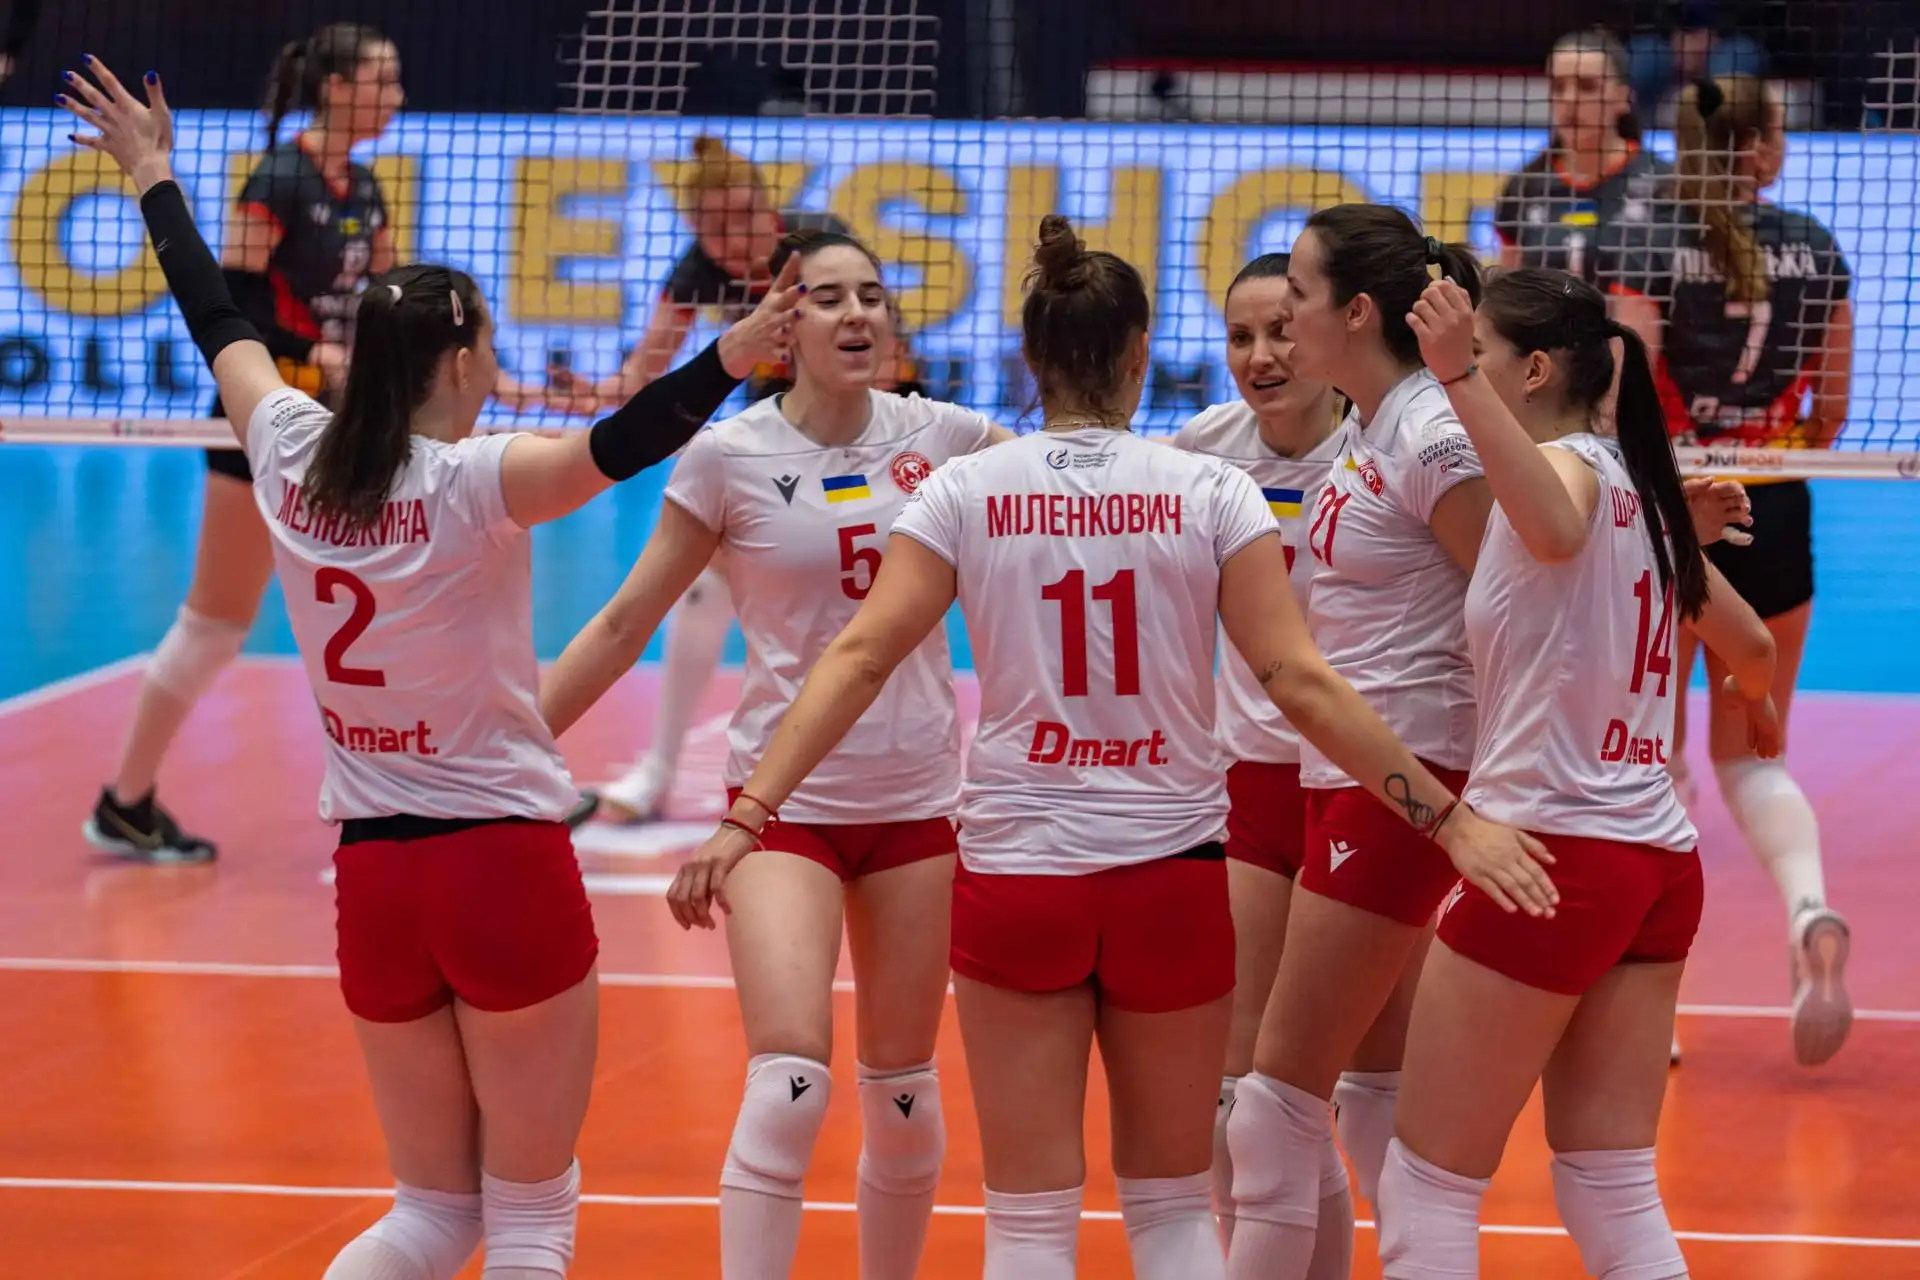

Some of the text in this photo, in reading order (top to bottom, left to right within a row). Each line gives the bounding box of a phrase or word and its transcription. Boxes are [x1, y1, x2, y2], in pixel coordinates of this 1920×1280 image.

[837, 523, 882, 600] 5
[987, 493, 1182, 538] МІЛЕНКОВИЧ
[1309, 484, 1351, 568] 21
[314, 566, 386, 687] 2
[1041, 568, 1141, 697] 11
[1629, 568, 1676, 697] 14
